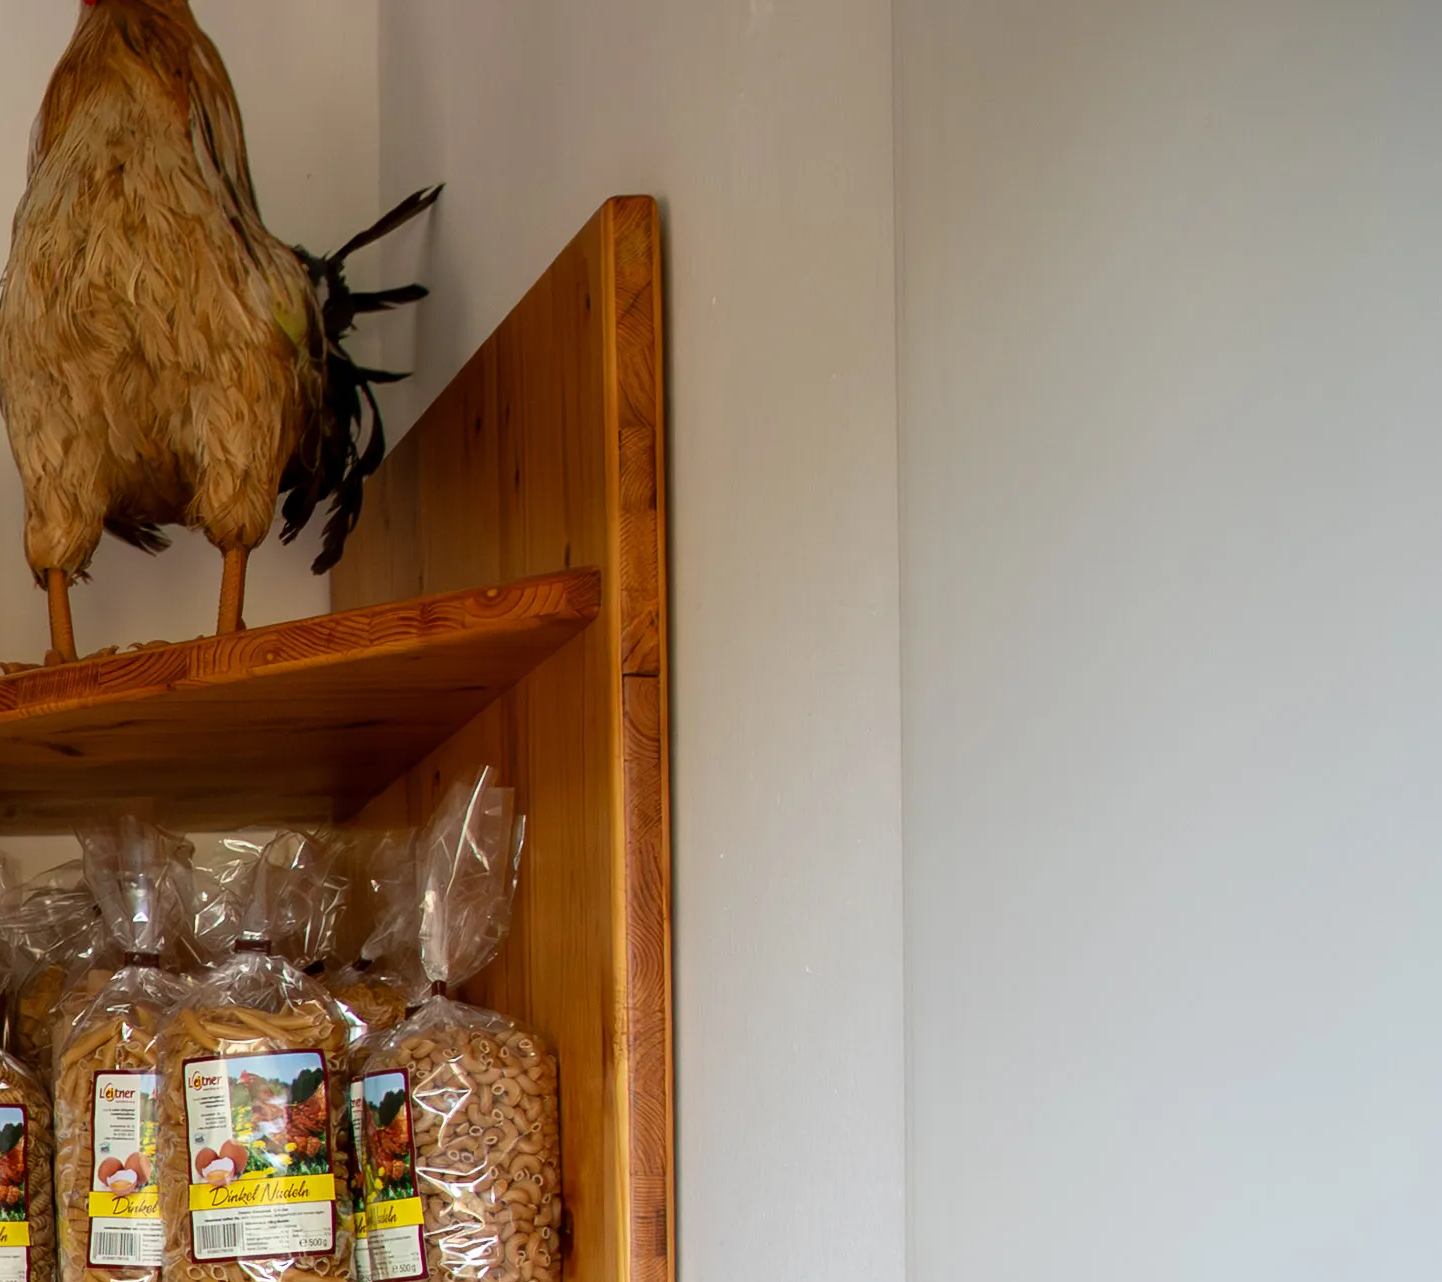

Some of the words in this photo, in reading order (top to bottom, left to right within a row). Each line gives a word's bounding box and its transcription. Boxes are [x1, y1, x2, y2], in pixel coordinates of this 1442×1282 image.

[187, 1071, 223, 1091] Leitner
[210, 1185, 258, 1207] Dinkel
[260, 1180, 310, 1204] Nudeln
